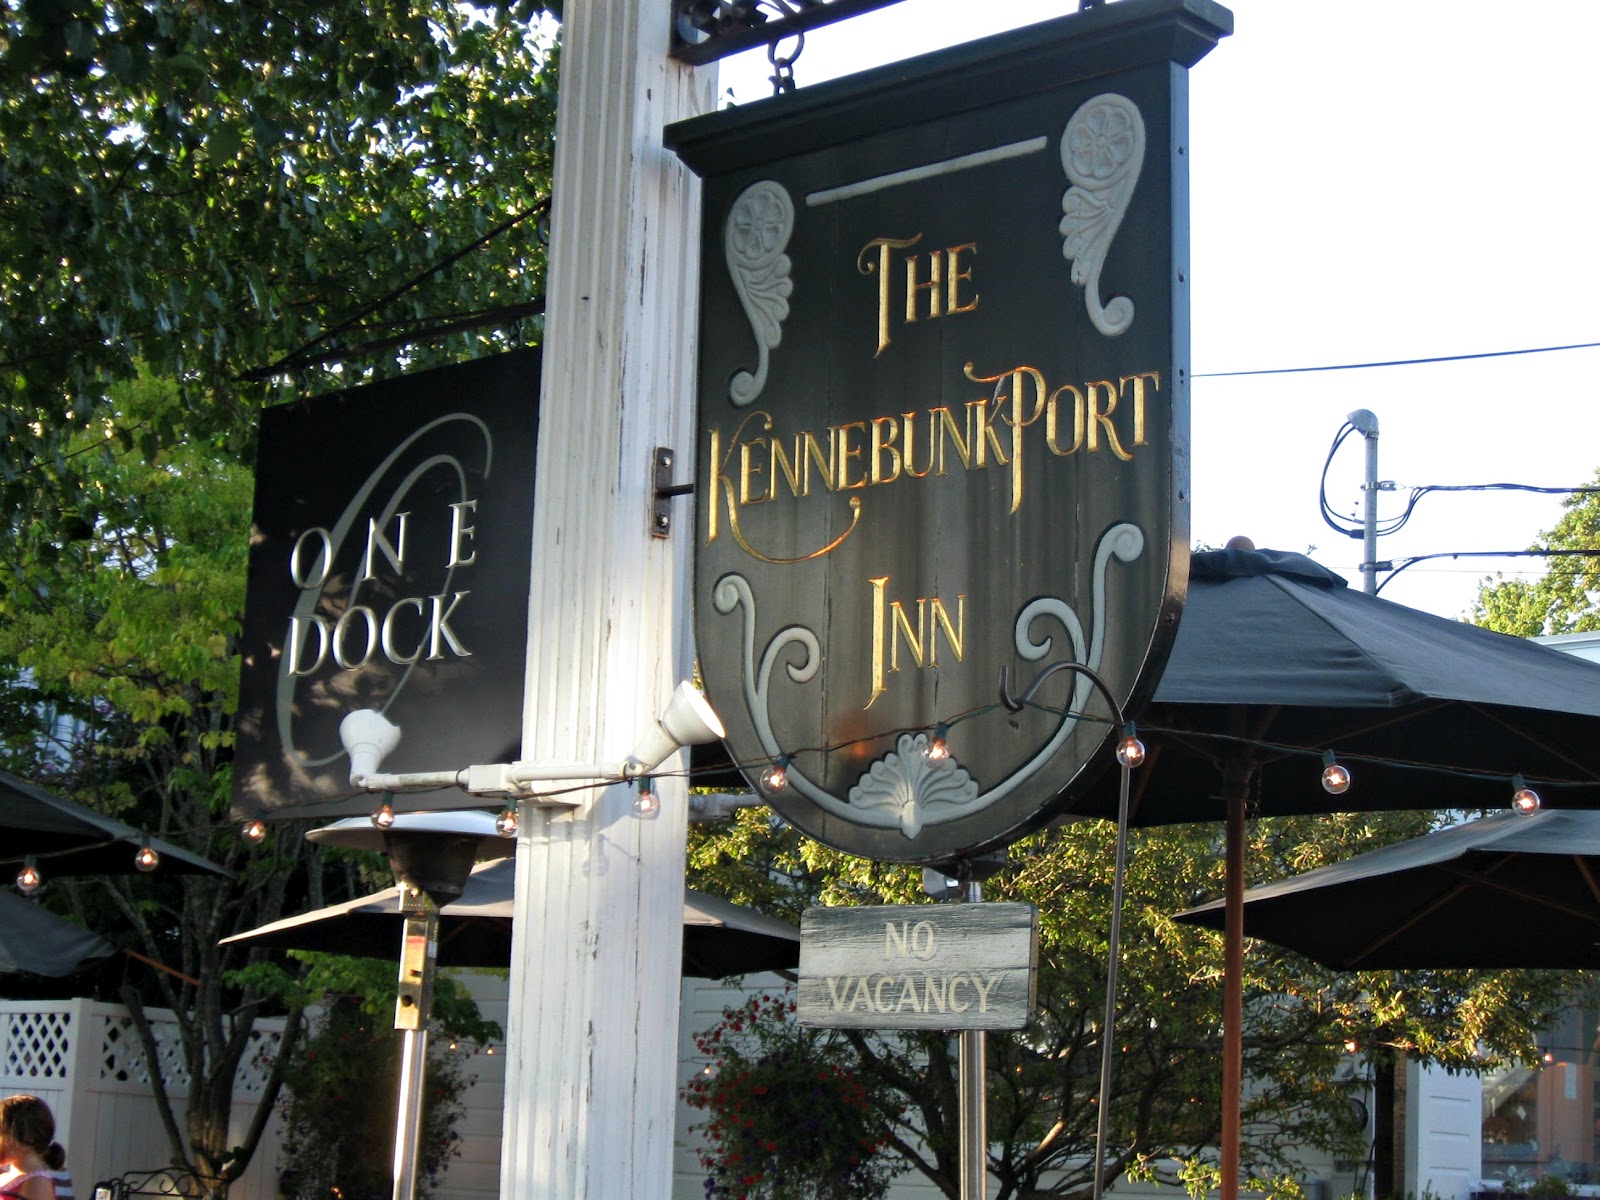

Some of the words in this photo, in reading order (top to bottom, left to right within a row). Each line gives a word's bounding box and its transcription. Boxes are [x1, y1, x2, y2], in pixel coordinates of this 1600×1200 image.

[857, 232, 979, 358] THE
[705, 361, 1161, 563] KENNEBUNKPORT
[290, 499, 478, 589] ONE
[285, 590, 472, 677] DOCK
[863, 576, 967, 710] INN
[883, 919, 936, 961] NO
[826, 975, 999, 1013] VACANCY
